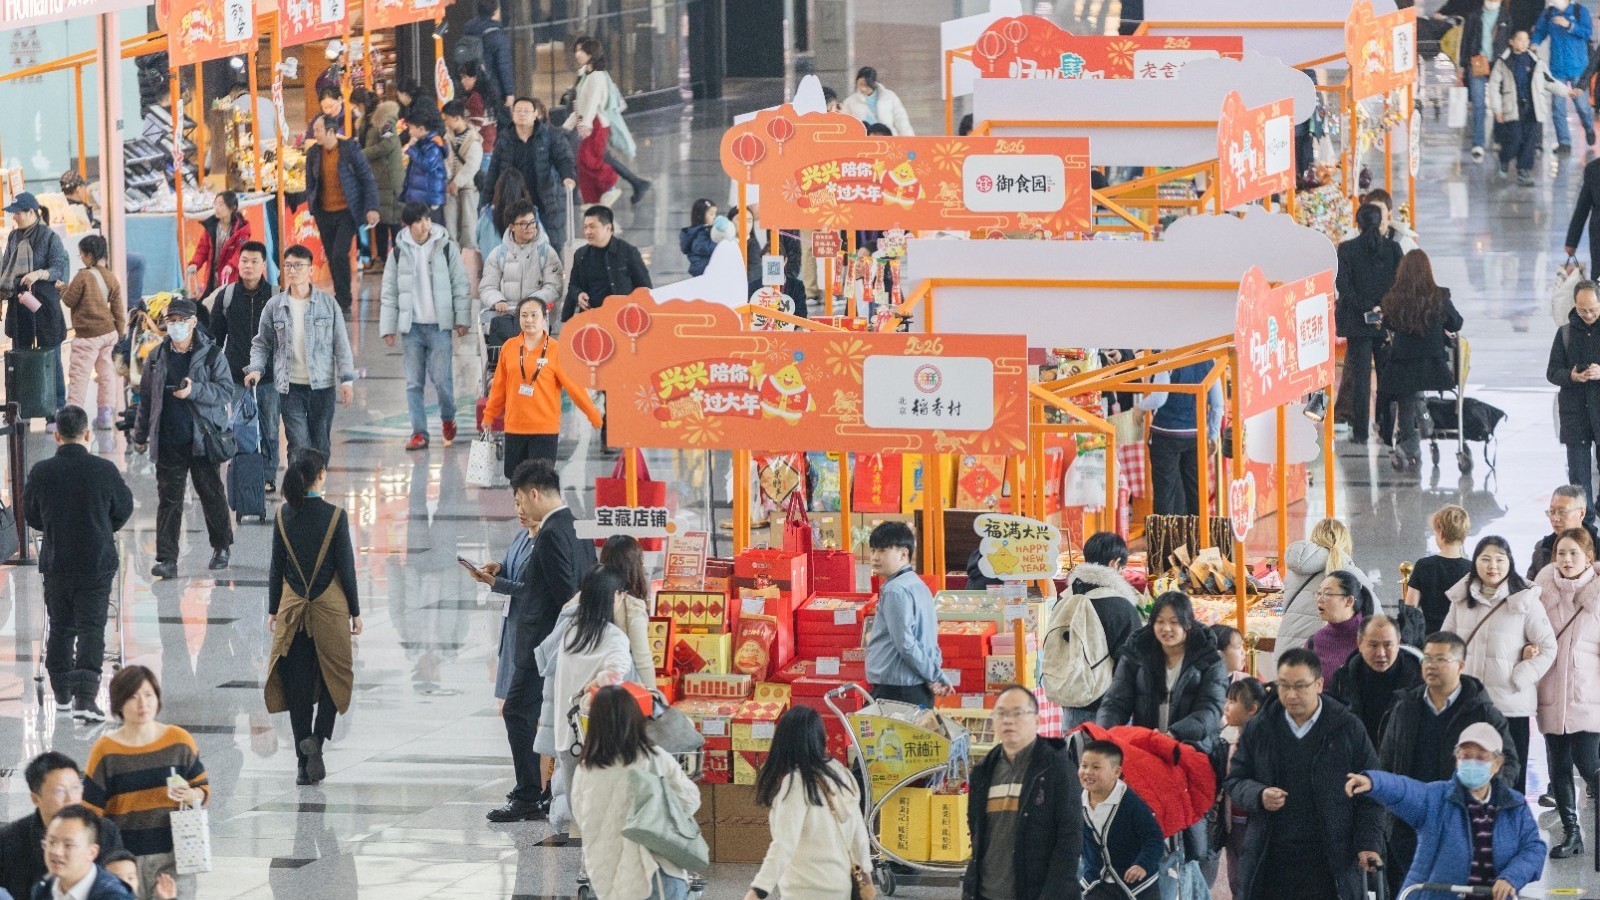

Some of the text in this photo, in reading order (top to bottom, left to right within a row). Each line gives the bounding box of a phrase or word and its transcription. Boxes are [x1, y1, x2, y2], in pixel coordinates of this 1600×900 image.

[994, 139, 1025, 154] 2026
[801, 160, 873, 191] 兴兴陪你
[996, 173, 1047, 193] 御食园
[836, 184, 882, 203] 过大年
[903, 336, 944, 355] 2026
[659, 361, 749, 399] 兴兴陪你
[703, 392, 761, 416] 过大年
[597, 508, 668, 528] 宝藏店铺
[984, 518, 1050, 540] 福满大兴
[1015, 543, 1049, 553] HAPPY
[1021, 563, 1047, 572] YEAR
[1022, 554, 1044, 562] NEW
[904, 741, 942, 758] 宋柚汁
